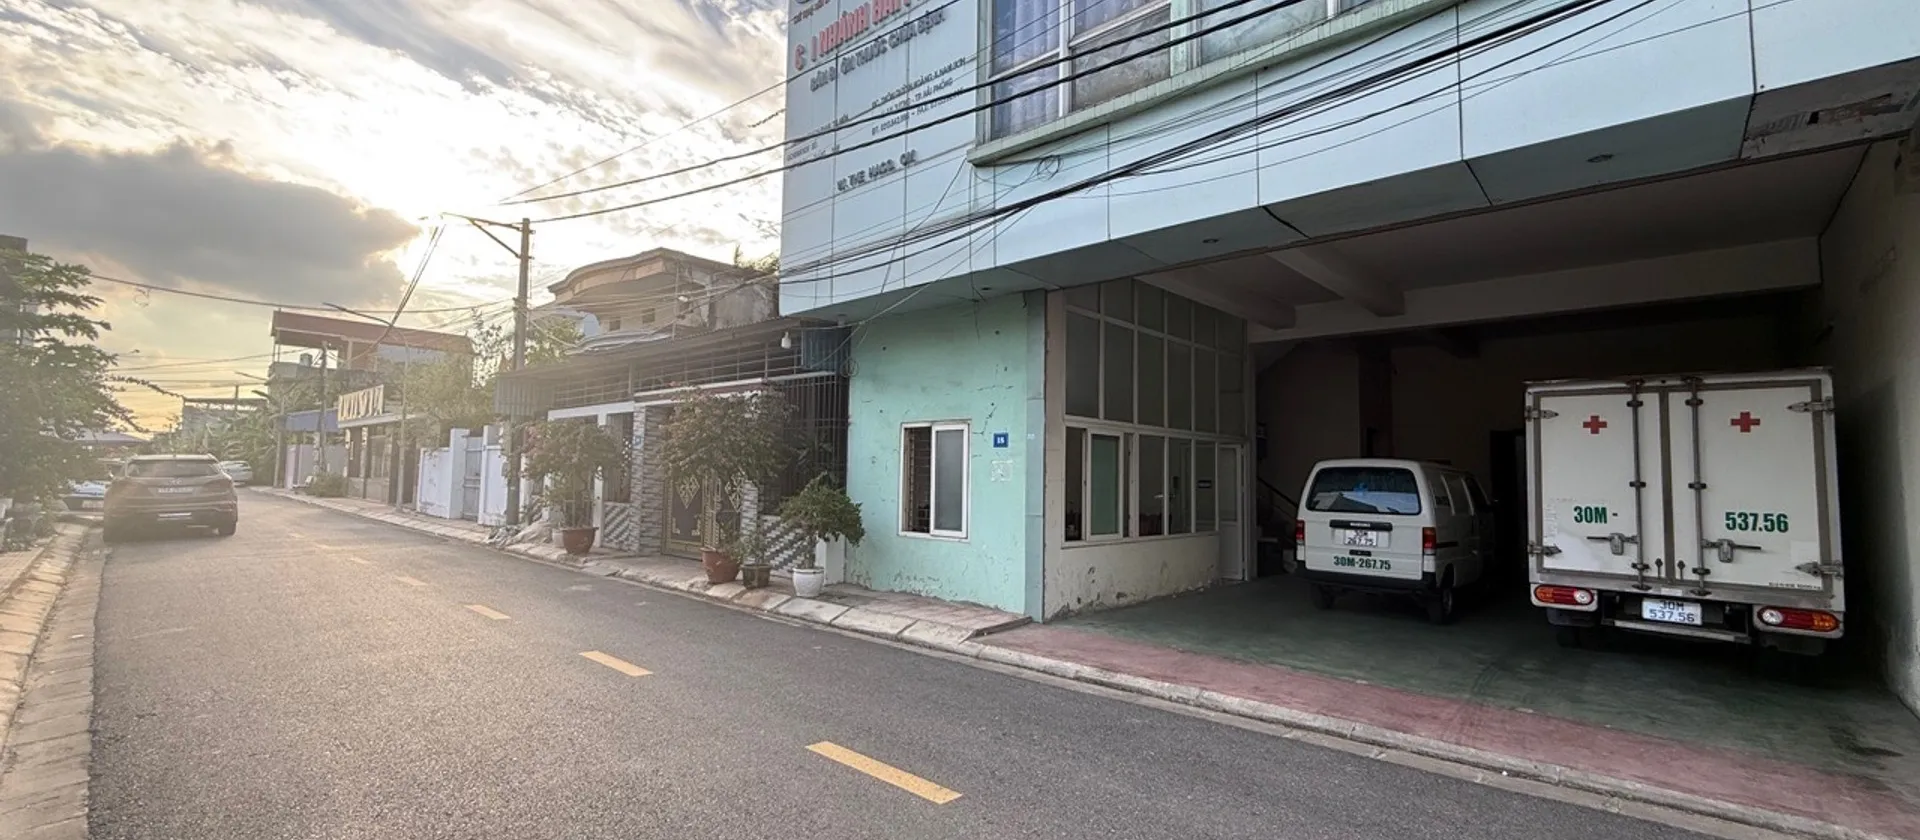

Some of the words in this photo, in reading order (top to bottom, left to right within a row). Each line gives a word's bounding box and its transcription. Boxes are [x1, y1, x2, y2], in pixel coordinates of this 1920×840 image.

[1573, 505, 1608, 525] 30M
[1725, 511, 1790, 533] 537.56
[1333, 556, 1392, 570] 30M-267.75
[1649, 609, 1695, 623] 537.56
